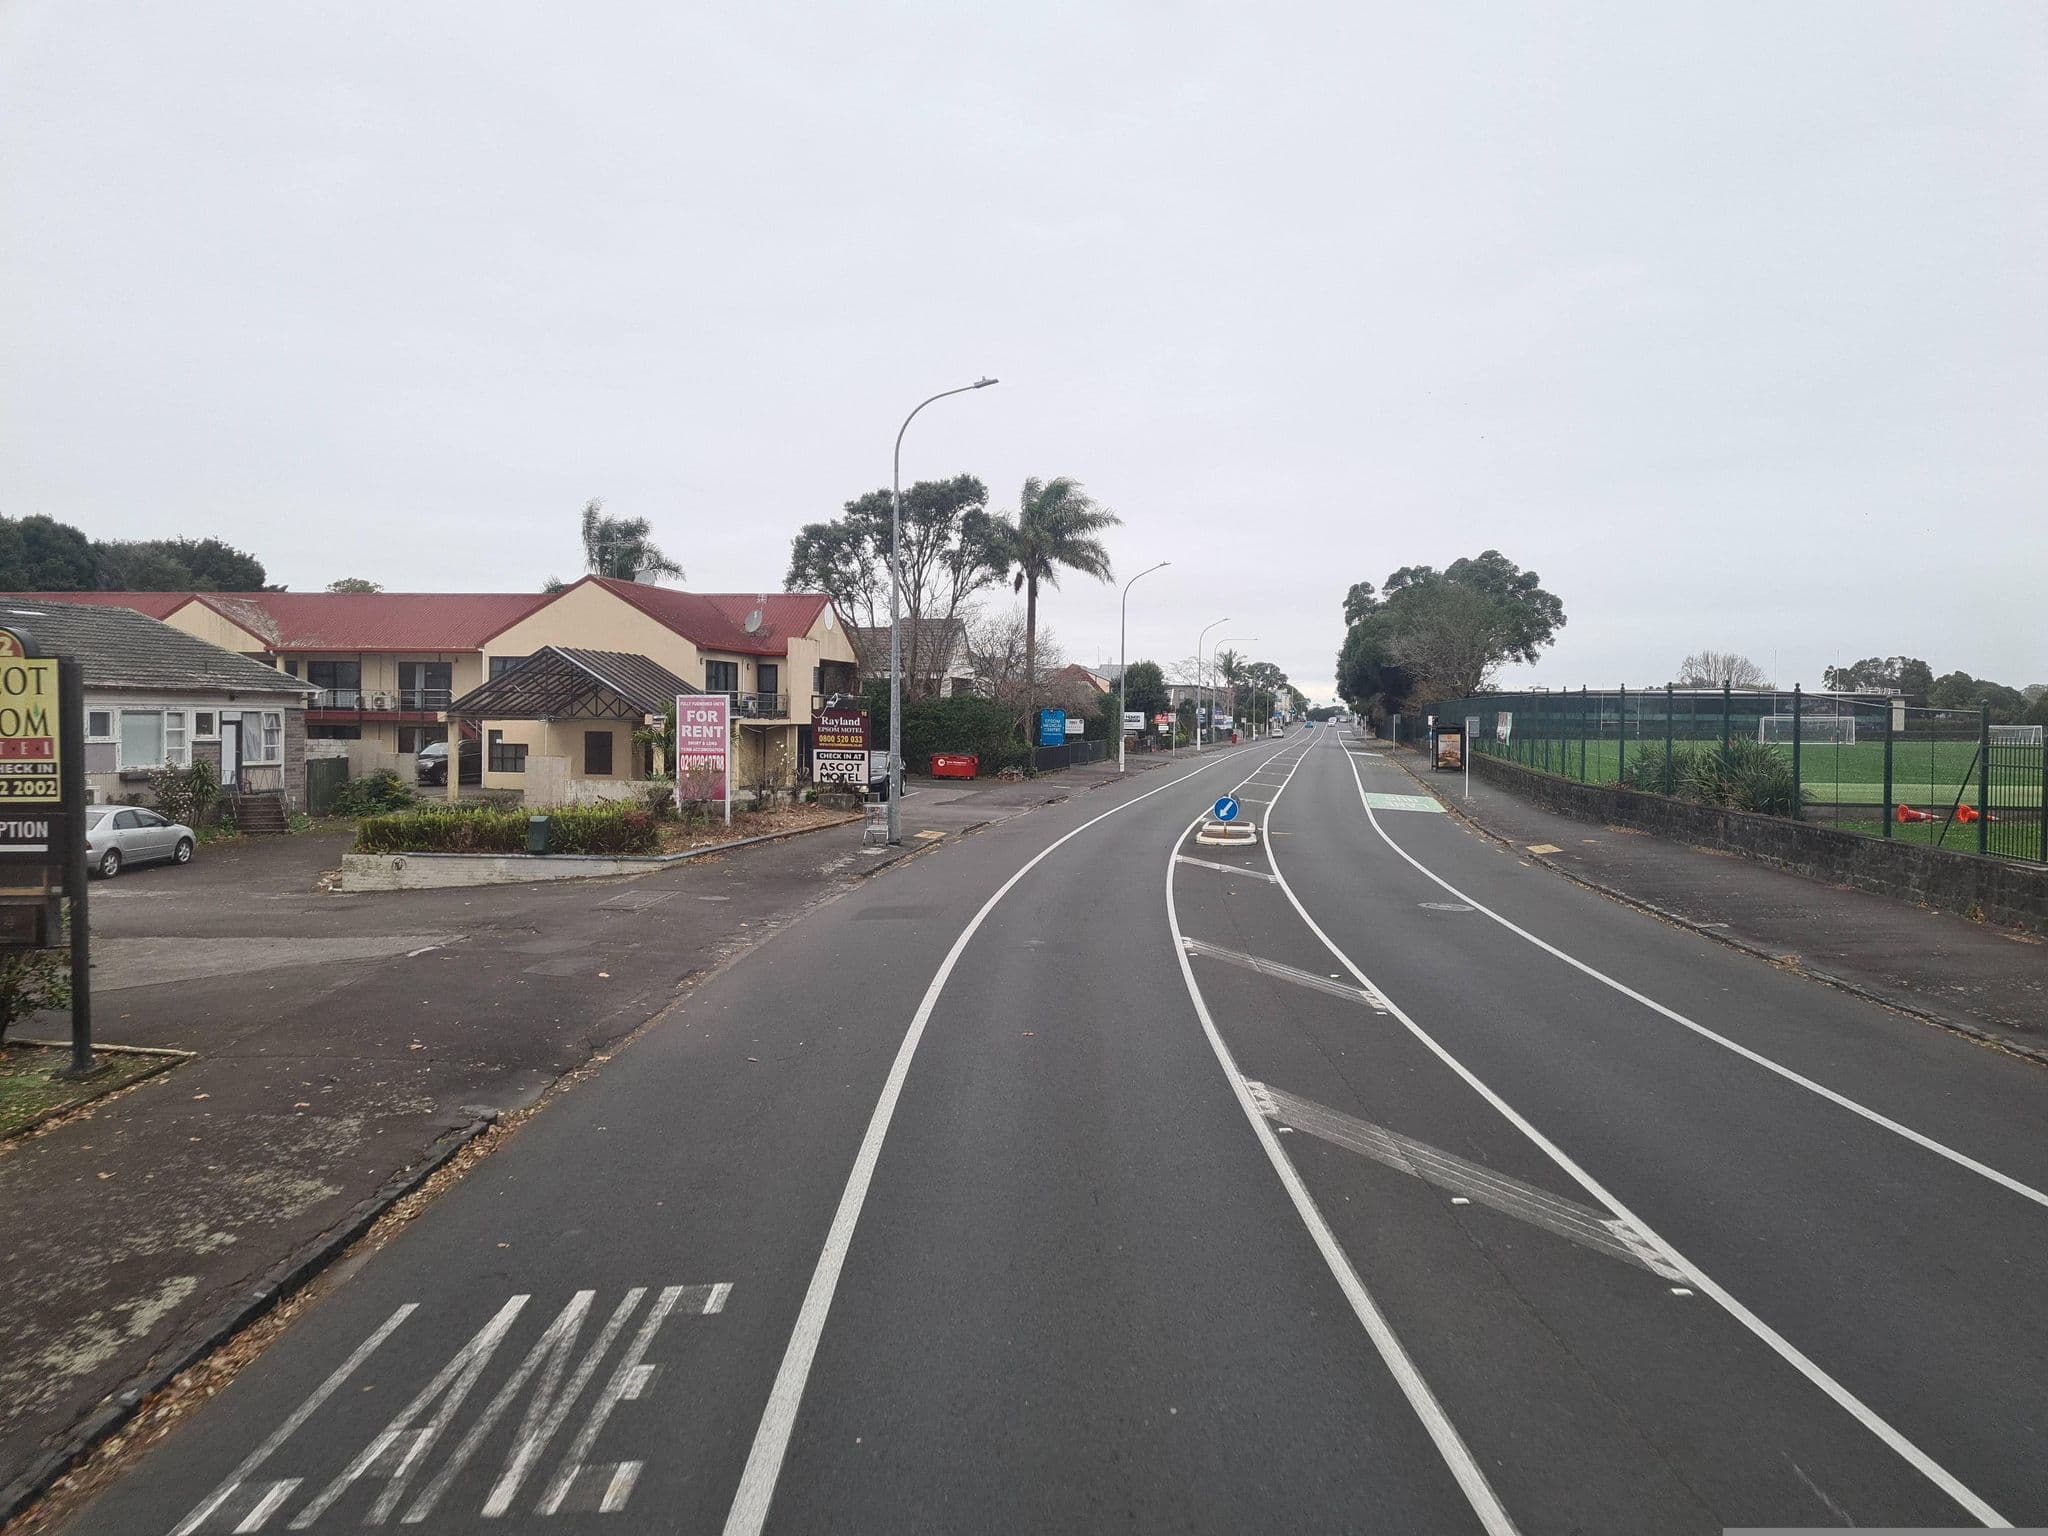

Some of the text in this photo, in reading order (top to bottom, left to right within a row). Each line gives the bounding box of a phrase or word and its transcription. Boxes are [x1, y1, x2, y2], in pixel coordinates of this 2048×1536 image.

[0, 667, 48, 696] OT
[687, 710, 718, 723] FOR
[821, 716, 860, 727] Rayland
[681, 725, 724, 738] RENT
[819, 734, 863, 744] 0800 520 033
[37, 764, 53, 773] IN
[820, 762, 862, 771] ASCOT
[820, 772, 862, 782] MOTEL
[13, 780, 56, 795] 2002
[166, 1283, 733, 1536] LANE
